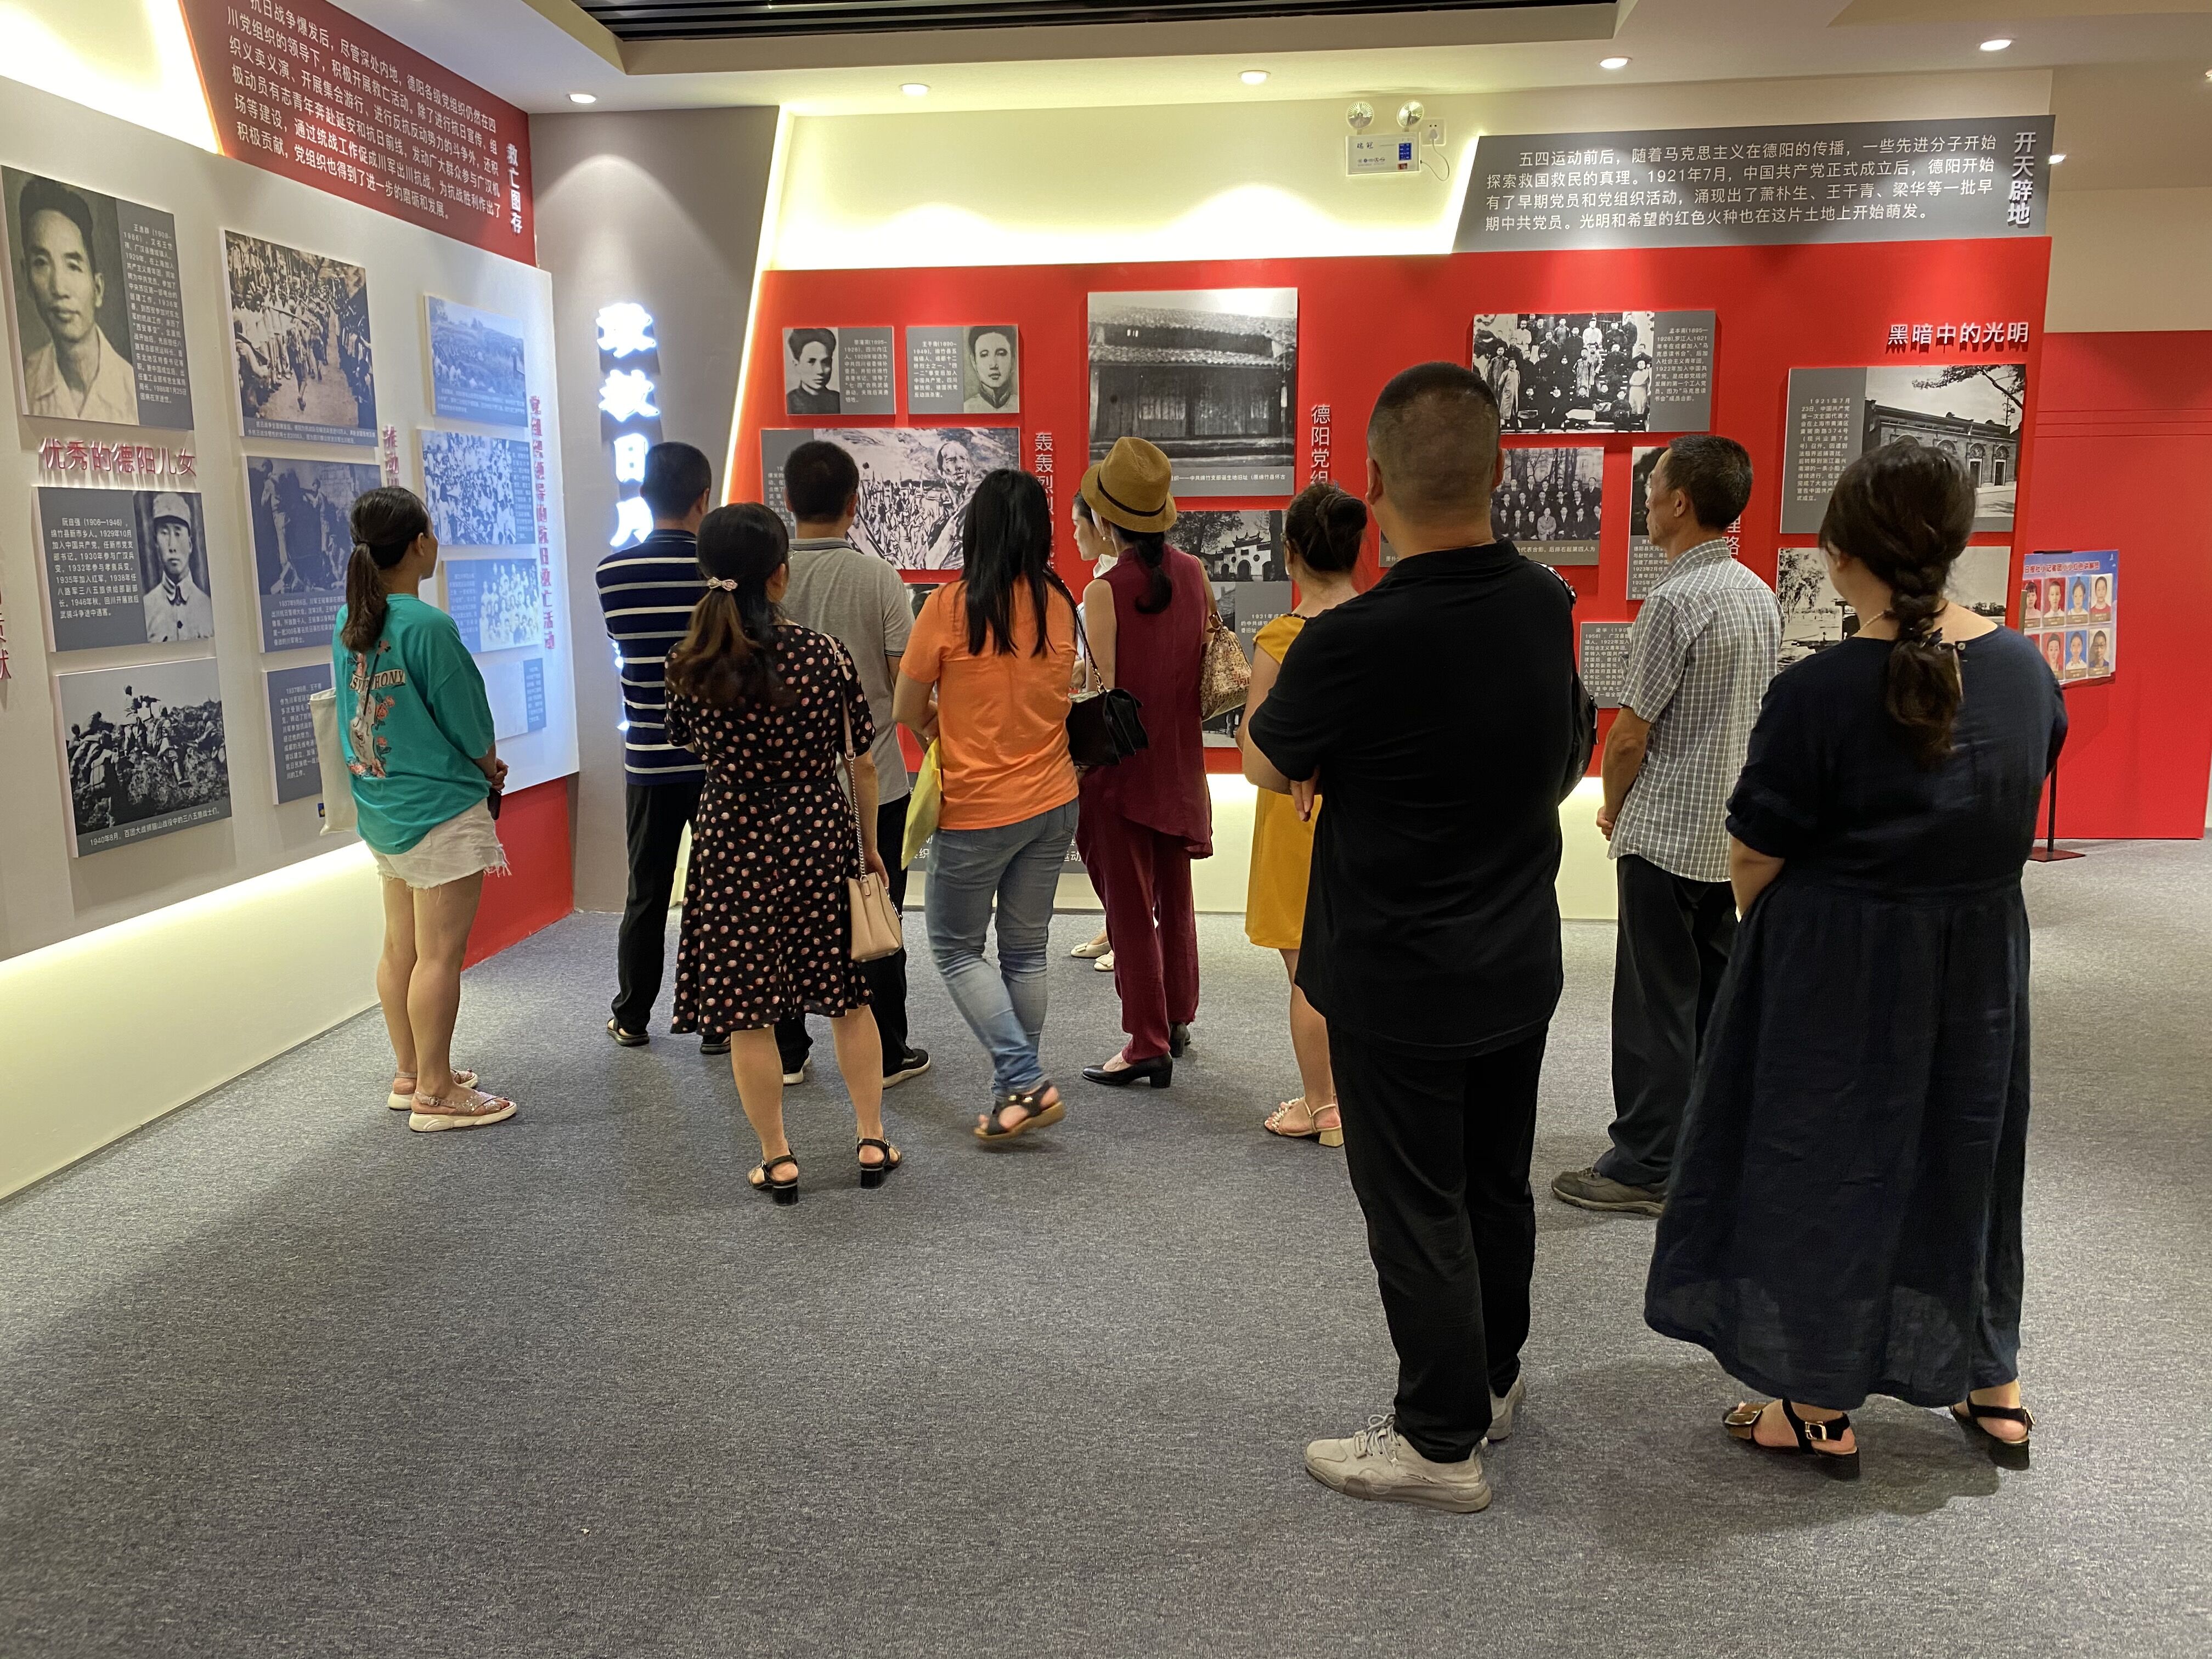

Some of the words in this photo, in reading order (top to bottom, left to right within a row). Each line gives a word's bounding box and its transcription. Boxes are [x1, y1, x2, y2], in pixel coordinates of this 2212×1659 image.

[1519, 134, 1996, 167] 五四运动前后，随着马克思主义在德阳的传播，一些先进分子开始
[506, 143, 522, 234] 救亡图存
[1486, 157, 1995, 190] 探索救国救民的真理。1921年7月，中国共产党正式成立后，德阳开始
[2007, 132, 2036, 226] 开天辟地
[1486, 179, 1993, 211] 有了早期党员和党组织活动，涌现出了萧朴生、王干青、梁华等一批早
[1485, 202, 1928, 232] 期中共党员。光明和希望的红色火种也在这片土地上开始萌发。
[1888, 321, 2029, 346] 黑暗中的光明
[38, 437, 197, 477] 优秀的德阳儿女
